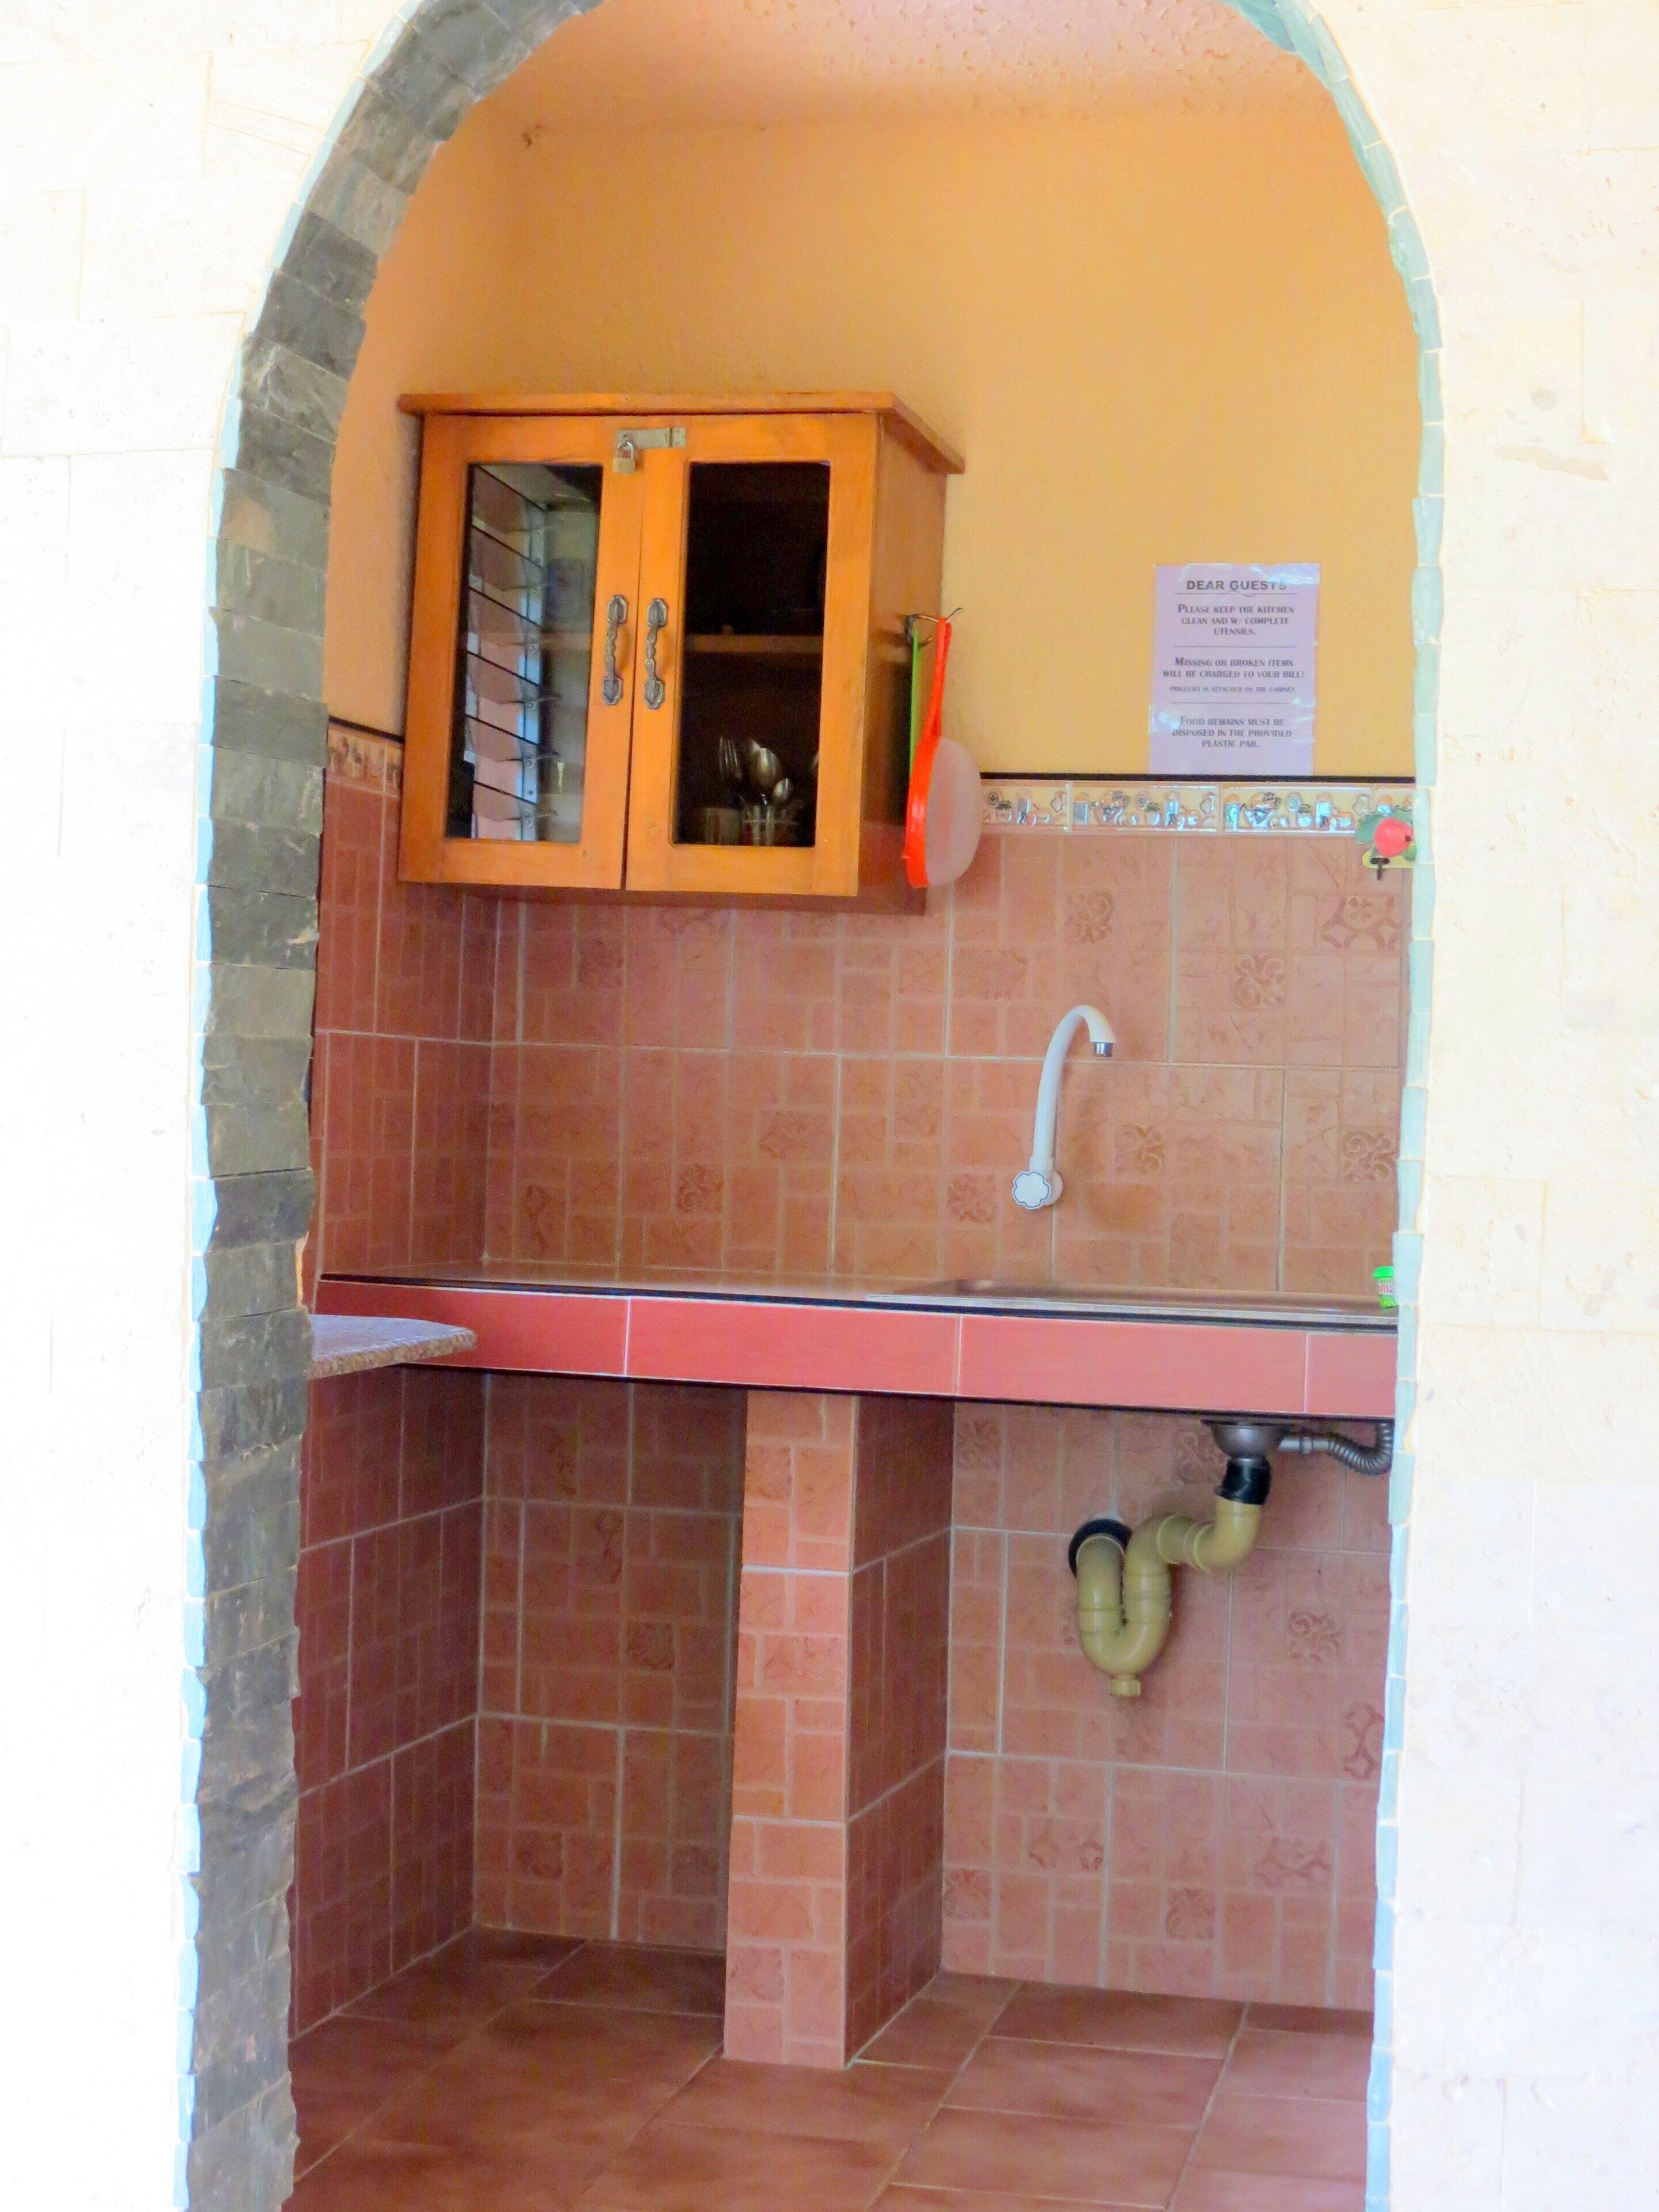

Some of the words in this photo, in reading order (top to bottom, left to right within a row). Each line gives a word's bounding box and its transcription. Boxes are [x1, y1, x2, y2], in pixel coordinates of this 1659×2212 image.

[1187, 581, 1224, 590] DEAR
[1230, 581, 1287, 590] GUESTS
[1180, 716, 1205, 725] FOOD
